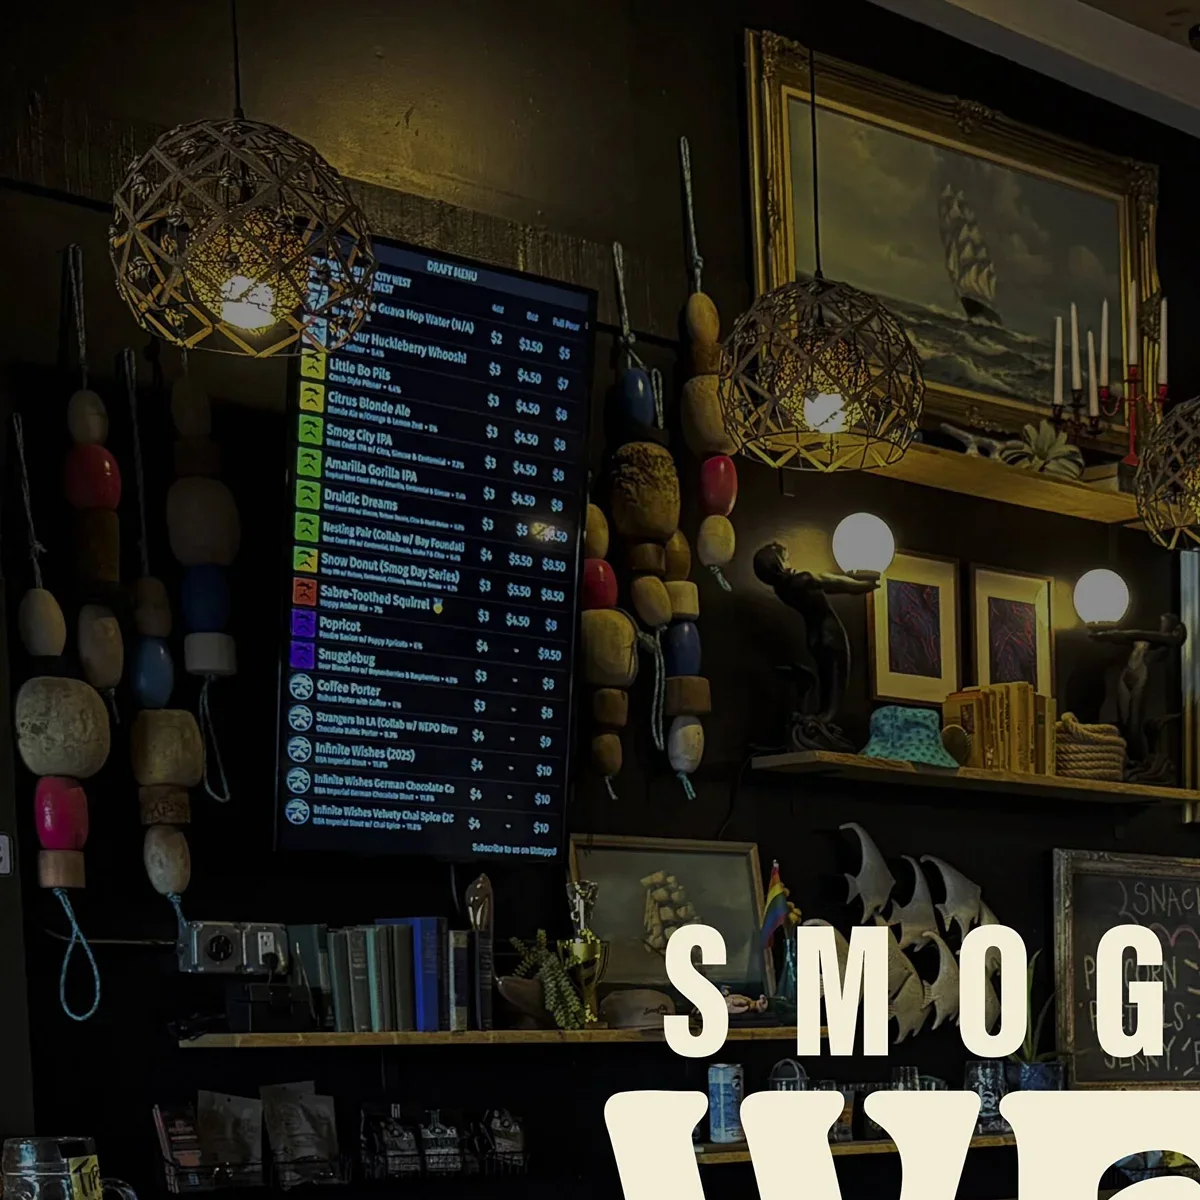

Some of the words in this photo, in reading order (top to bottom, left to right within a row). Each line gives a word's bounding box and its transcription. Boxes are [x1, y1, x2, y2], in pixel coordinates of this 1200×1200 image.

[375, 271, 392, 283] CITY
[392, 275, 412, 288] WEST
[427, 260, 452, 276] DRAFT
[454, 267, 477, 282] MENU
[378, 302, 404, 318] Guava
[406, 309, 425, 324] Hop
[426, 313, 450, 328] Water
[491, 330, 502, 345] $2
[371, 333, 427, 358] Huckleberry
[428, 345, 467, 364] Whoosh!
[330, 358, 356, 374] Little
[357, 364, 370, 377] Bo
[372, 366, 391, 381] Pils
[489, 362, 501, 376] $3
[328, 391, 357, 407] Citrus
[359, 396, 394, 414] Blonde
[394, 404, 411, 417] Ale
[488, 393, 499, 407] $3
[326, 423, 355, 441] Smog
[356, 429, 376, 445] City
[377, 432, 392, 446] IPA
[486, 424, 498, 438] $3
[325, 456, 366, 474] Amarilla
[368, 464, 400, 480] Gorilla
[402, 469, 417, 483] IPA
[484, 455, 496, 469] $3
[324, 488, 360, 505] Druidic
[362, 494, 398, 511] Dreams
[483, 486, 495, 500] $3
[482, 517, 494, 531] $3
[323, 521, 355, 538] Nesting
[356, 526, 372, 538] Pair
[373, 528, 401, 543] (Collab
[402, 534, 414, 546] w/
[414, 535, 429, 549] Bay
[321, 552, 348, 567] Snow
[349, 556, 378, 572] Donut
[380, 560, 409, 578] (Smog
[410, 565, 428, 580] Day
[428, 568, 460, 584] Series)
[479, 578, 491, 592] $3
[507, 582, 531, 597] $5.50
[320, 584, 391, 605] Sabre-Toothed
[393, 594, 430, 610] Squirrel
[320, 616, 361, 632] Popricot
[478, 608, 490, 623] $3
[318, 648, 376, 667] Snugglebug
[475, 669, 487, 683] $3
[317, 679, 348, 693] Coffee
[350, 683, 381, 696] Porter
[474, 699, 486, 713] $3
[316, 712, 355, 726] Strangers
[366, 716, 376, 726] LA
[377, 717, 405, 729] (Collab
[316, 742, 350, 756] Infinite
[351, 745, 385, 759] Wishes
[386, 747, 416, 762] (2025)
[536, 764, 552, 777] $10
[314, 774, 344, 785] Infinite
[344, 776, 373, 787] Wishes
[374, 778, 405, 790] German
[406, 780, 444, 792] Chocolate
[535, 792, 550, 806] $10
[313, 804, 342, 816] Infinite
[343, 806, 372, 818] Wishes
[373, 808, 401, 821] Velvety
[402, 810, 420, 820] Chai
[420, 812, 441, 823] Spice
[534, 821, 549, 834] $10
[472, 843, 504, 853] Subscribe
[504, 845, 511, 854] to
[530, 846, 557, 857] Untappd
